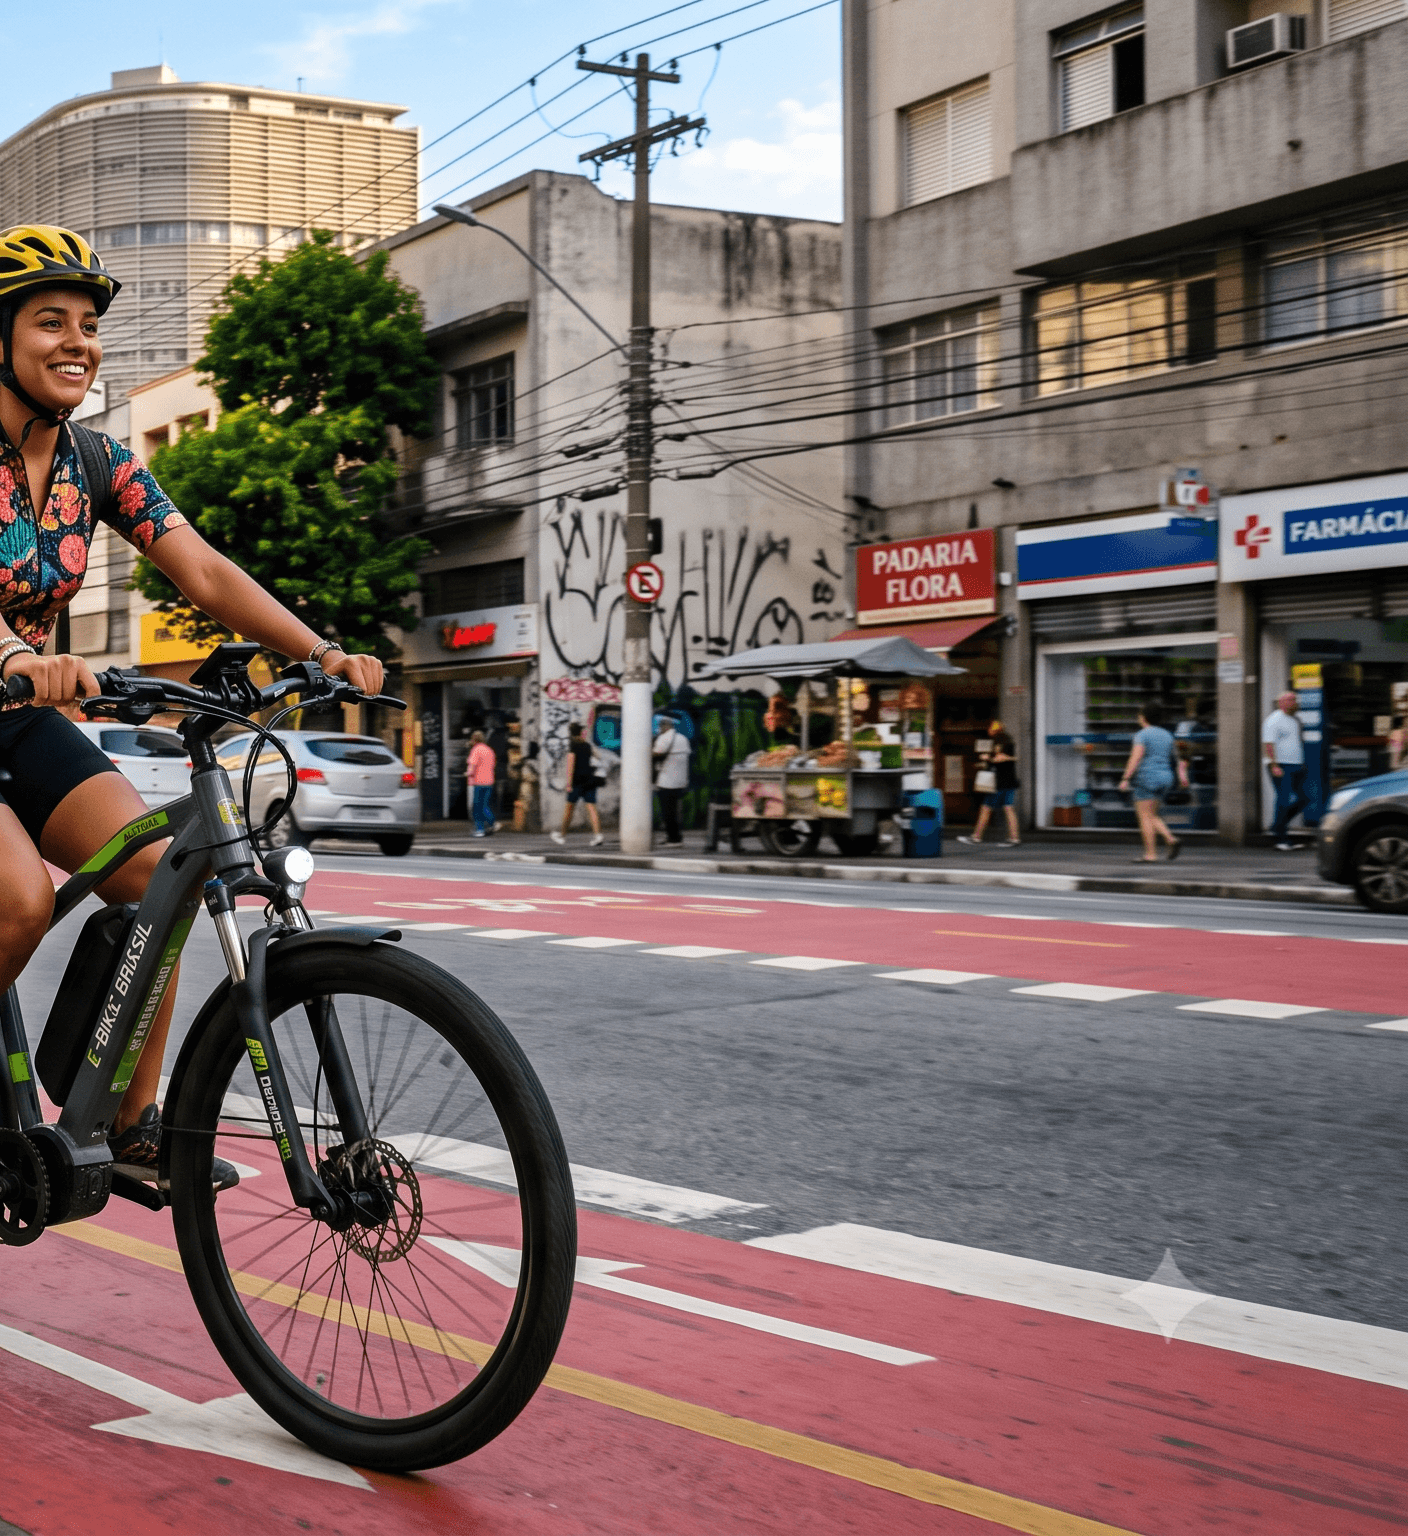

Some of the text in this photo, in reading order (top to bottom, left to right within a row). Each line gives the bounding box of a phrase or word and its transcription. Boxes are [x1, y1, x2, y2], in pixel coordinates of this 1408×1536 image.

[1289, 507, 1408, 543] FARMÁCI
[872, 539, 979, 576] PADARIA
[885, 571, 965, 604] FLORA
